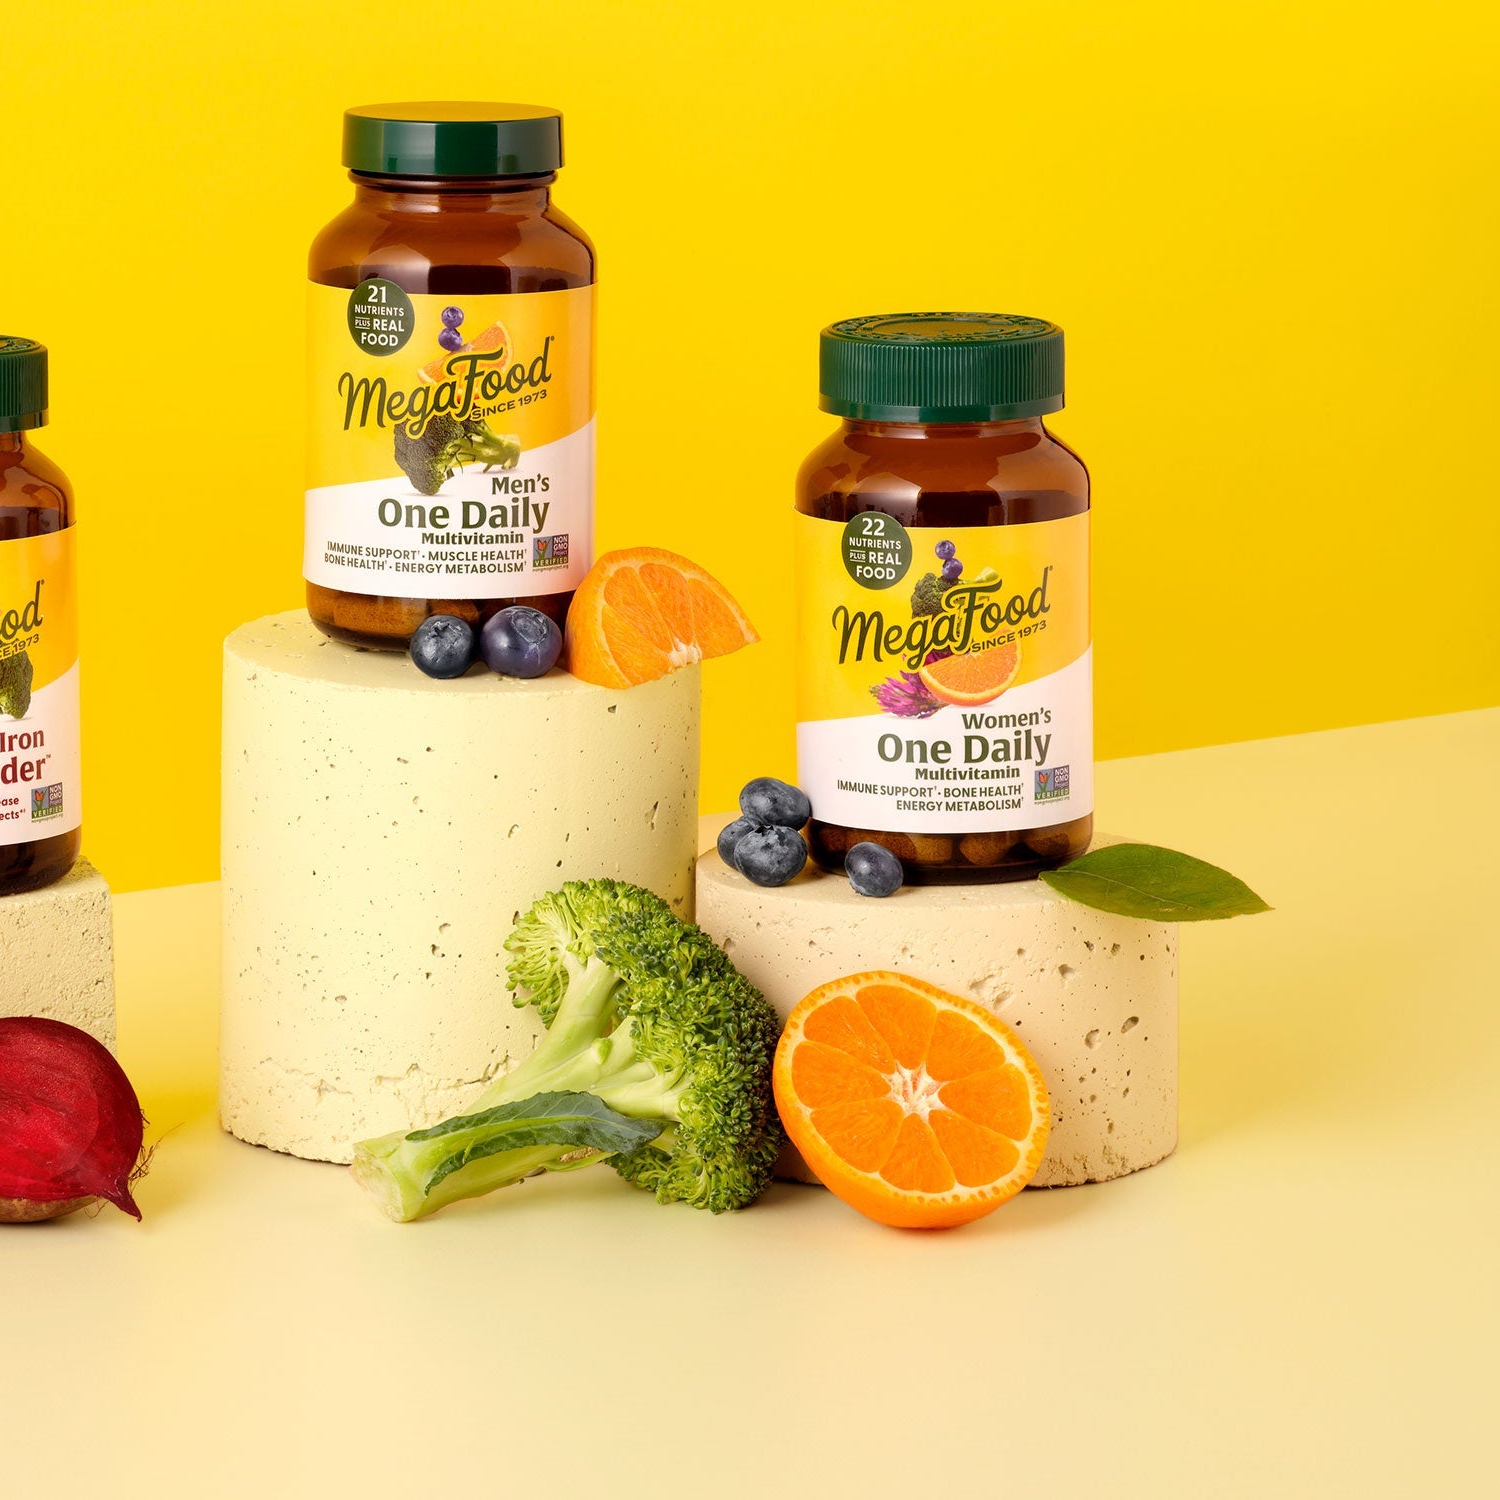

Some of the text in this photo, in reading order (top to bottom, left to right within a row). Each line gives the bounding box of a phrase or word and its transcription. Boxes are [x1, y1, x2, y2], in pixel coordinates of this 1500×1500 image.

[368, 285, 387, 303] 21
[355, 305, 404, 317] NUTRIENTS
[355, 318, 404, 331] PLUS REAL
[361, 332, 398, 346] FOOD
[471, 389, 547, 419] SINCE 1973
[492, 473, 549, 495] Men’s
[378, 497, 550, 533] One Daily
[862, 518, 884, 536] 22
[422, 532, 524, 544] Multivitamin
[554, 535, 568, 543] NON
[850, 537, 901, 550] NUTRIENTS
[327, 541, 364, 555] IMMUNE
[428, 551, 478, 561] MUSCLE
[325, 553, 346, 566] BONE
[395, 563, 442, 573] ENERGY
[535, 557, 567, 566] VERIFIED
[850, 552, 901, 565] PLUS REAL
[856, 566, 896, 580] FOOD
[972, 621, 1046, 653] SINCE 1973
[13, 634, 40, 655] 1973
[962, 707, 1052, 729] Women’s
[0, 730, 44, 752] Iron
[877, 729, 1052, 766] One Daily
[915, 766, 1020, 780] Multivitamin
[1055, 767, 1068, 776] NON
[1055, 774, 1068, 782] GMO
[50, 785, 61, 793] NON
[837, 780, 878, 794] IMMUNE
[944, 786, 977, 798] BONE
[1037, 788, 1068, 799] VERIFIED
[33, 806, 62, 817] VERIFIED
[897, 800, 944, 812] ENERGY
